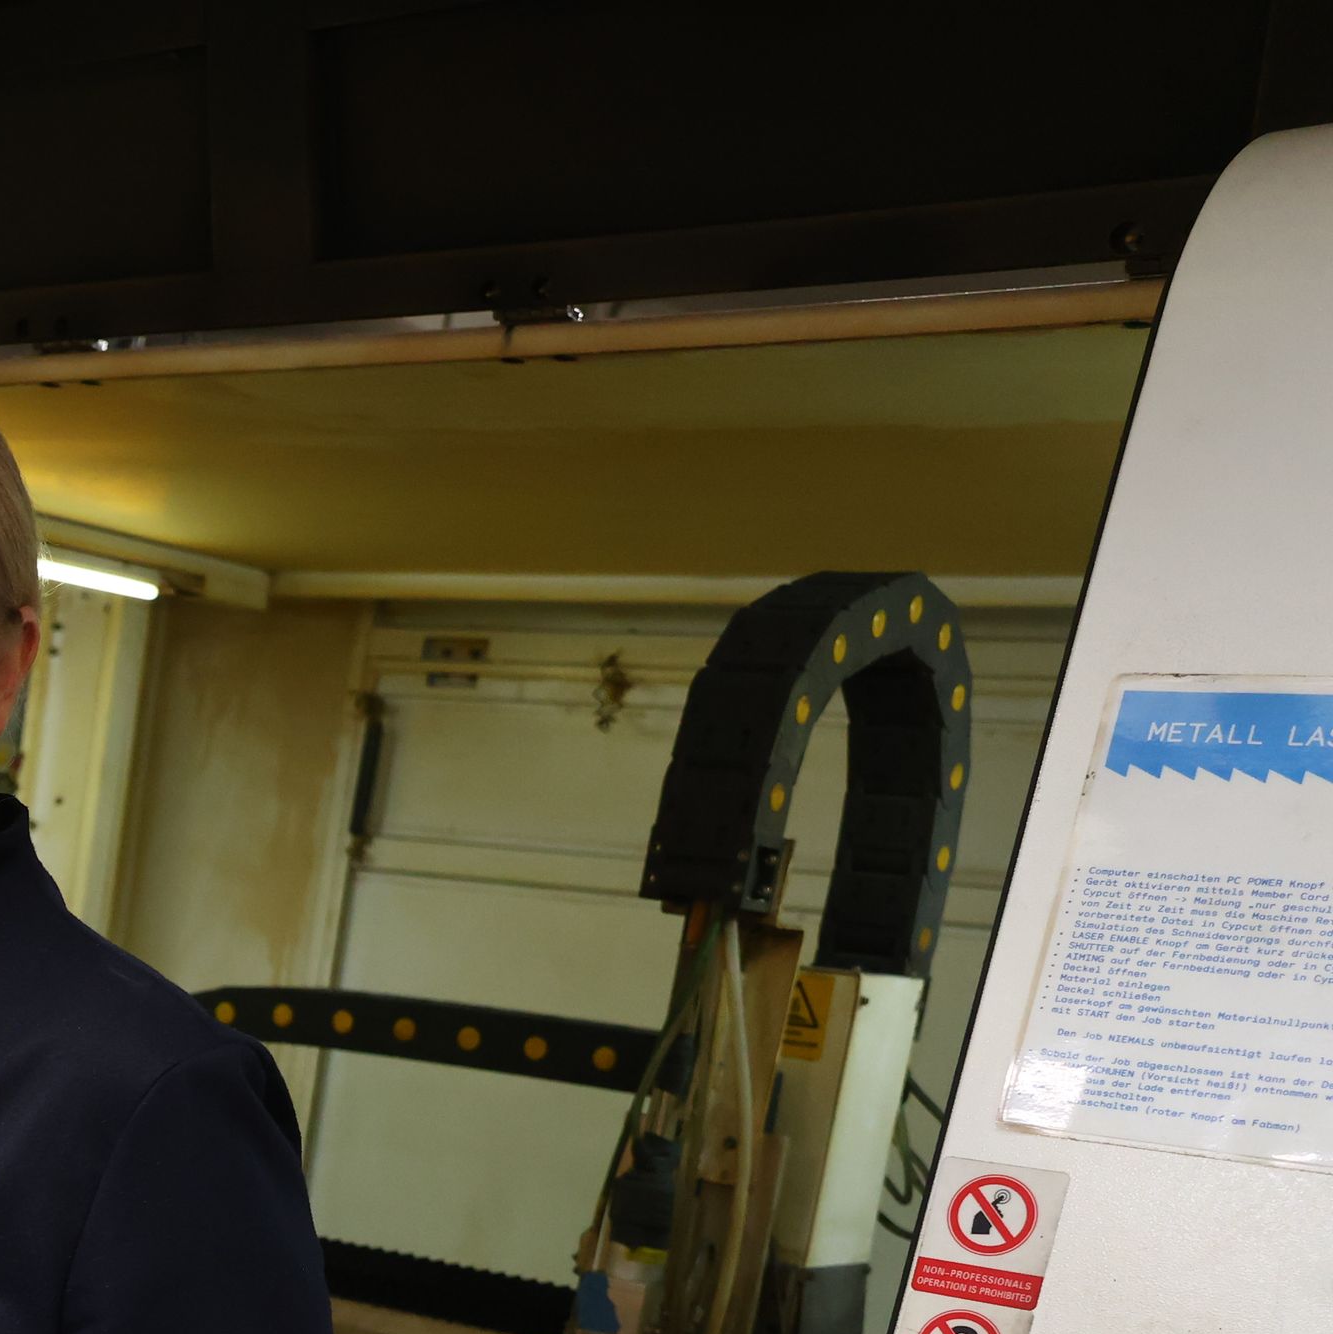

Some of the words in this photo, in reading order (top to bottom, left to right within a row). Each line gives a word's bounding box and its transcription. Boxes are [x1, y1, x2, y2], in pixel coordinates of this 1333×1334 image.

[1147, 722, 1263, 745] METALL
[1085, 876, 1118, 887] Gerät
[1124, 880, 1190, 892] aktivieren
[1196, 886, 1244, 896] mittels
[1250, 889, 1293, 899] Member
[1299, 891, 1329, 901] Card
[1088, 866, 1140, 877] Computer
[1146, 871, 1220, 882] einschalten
[1226, 875, 1241, 884] PC
[1246, 877, 1283, 887] POWER
[1288, 879, 1325, 890] Knopf
[1127, 891, 1167, 901] öffnen
[1193, 896, 1241, 908] Meldung
[1071, 930, 1104, 940] LASER
[1109, 933, 1149, 944] ENABLE
[1155, 938, 1189, 949] Knopf
[1214, 943, 1249, 953] Gerät
[1256, 946, 1284, 956] kurz
[1062, 962, 1100, 973] Deckel
[1107, 966, 1147, 977] öffnen
[1056, 983, 1094, 995] Deckel
[1102, 990, 1161, 1002] schließen
[1059, 973, 1110, 985] Material
[1117, 979, 1170, 991] einlegen
[1050, 1006, 1071, 1014] mit
[1076, 1008, 1110, 1018] START
[1115, 1012, 1135, 1021] den
[1141, 1015, 1162, 1024] Job
[1167, 1019, 1215, 1029] starten
[923, 1265, 1032, 1290] NON-PROFESSIONALS
[917, 1276, 966, 1292] OPERATION
[968, 1285, 977, 1293] IS
[979, 1287, 1032, 1303] PROHIBITED
